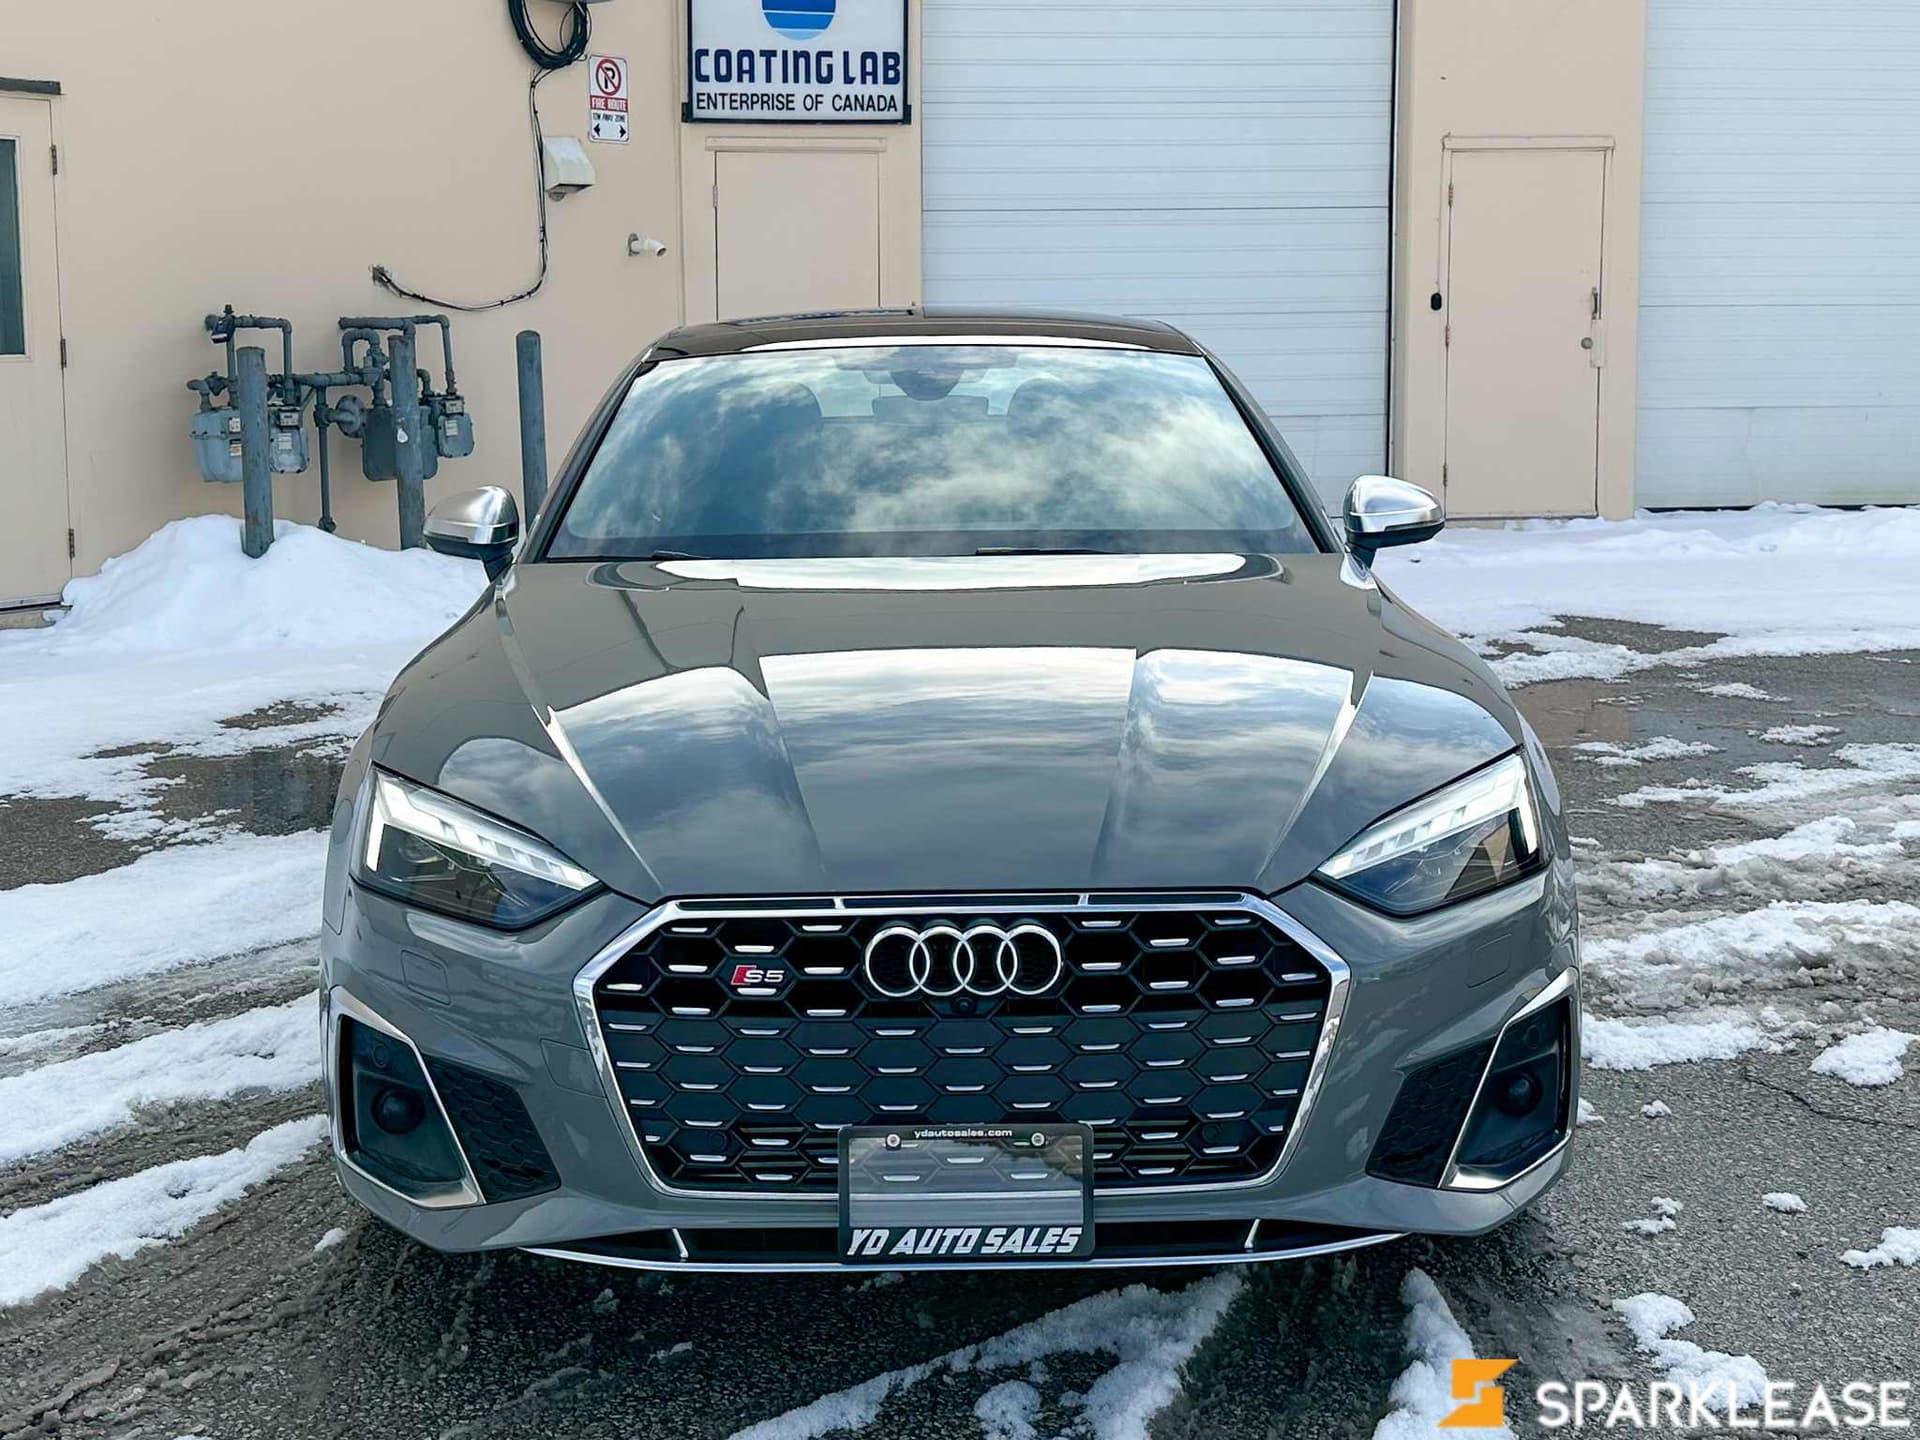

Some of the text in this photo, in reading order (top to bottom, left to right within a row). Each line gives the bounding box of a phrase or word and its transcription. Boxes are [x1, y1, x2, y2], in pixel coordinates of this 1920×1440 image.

[696, 92, 898, 112] ENTERPRISE OF CANADA
[743, 969, 785, 983] S5
[914, 1128, 1013, 1139] ydautosales.com
[847, 1227, 1083, 1256] YD AUTO SALES
